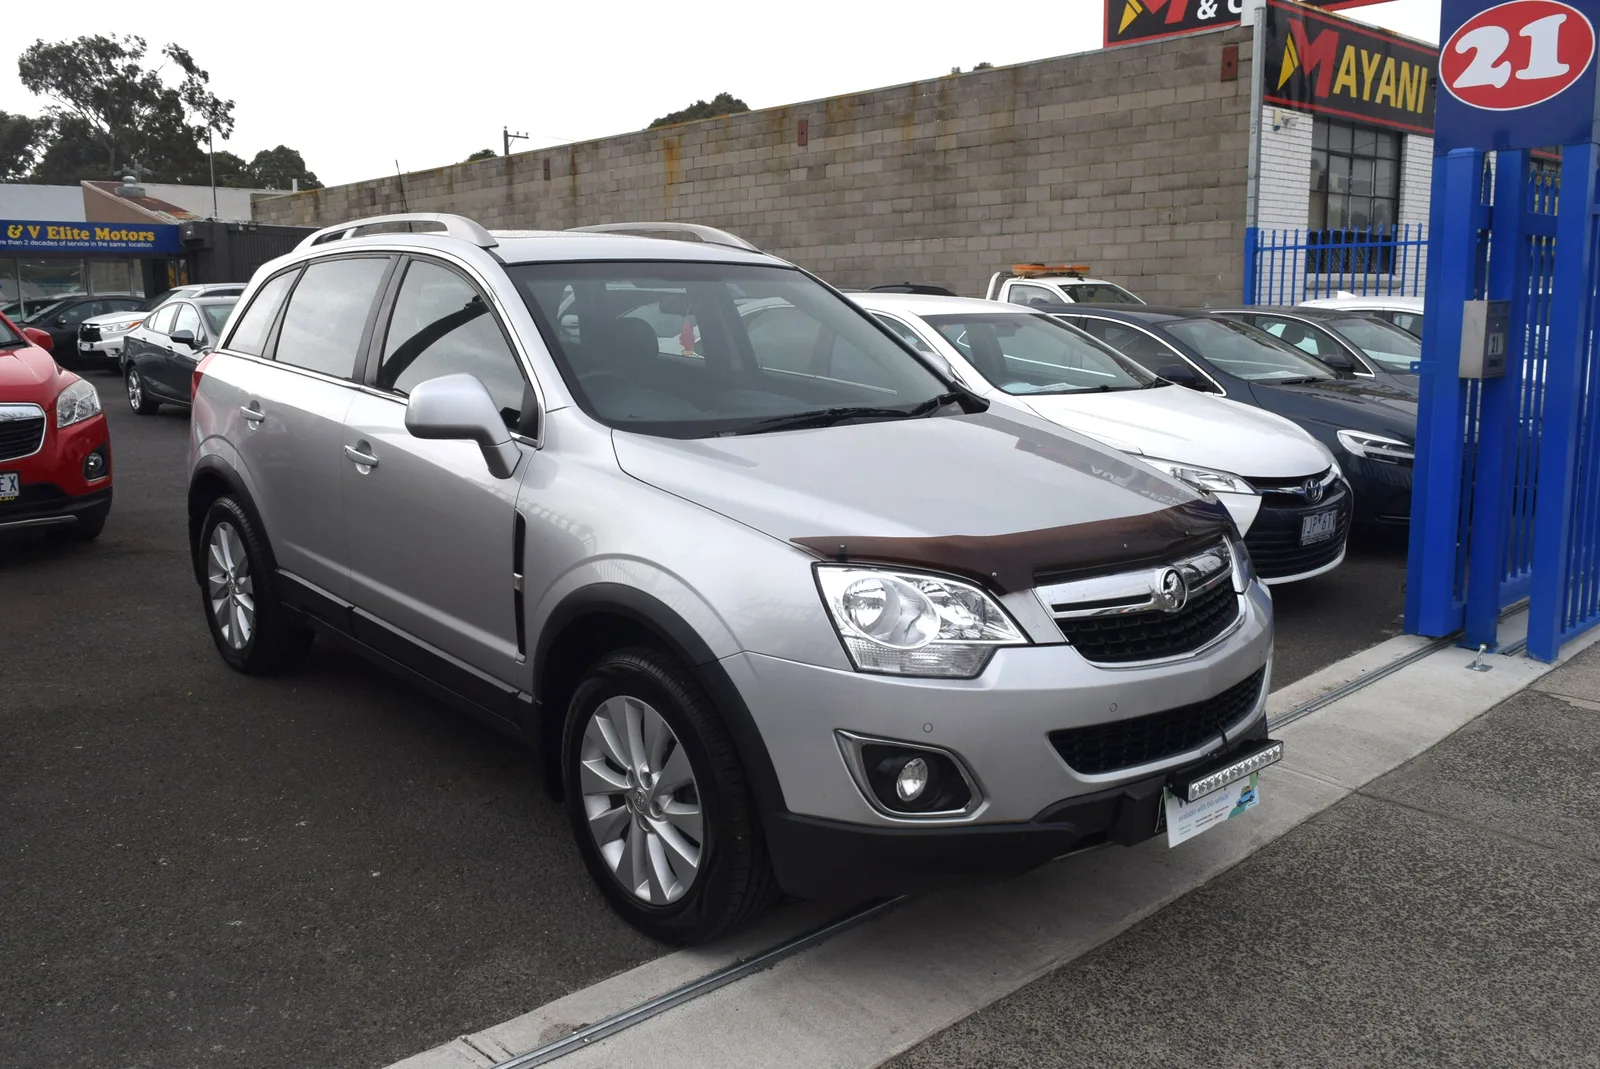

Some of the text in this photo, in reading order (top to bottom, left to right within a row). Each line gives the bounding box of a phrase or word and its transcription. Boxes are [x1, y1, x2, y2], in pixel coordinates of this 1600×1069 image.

[1288, 18, 1428, 114] MAYANI
[1452, 13, 1570, 88] 21
[7, 224, 155, 241] & V Elite Motors
[1491, 335, 1500, 354] 21
